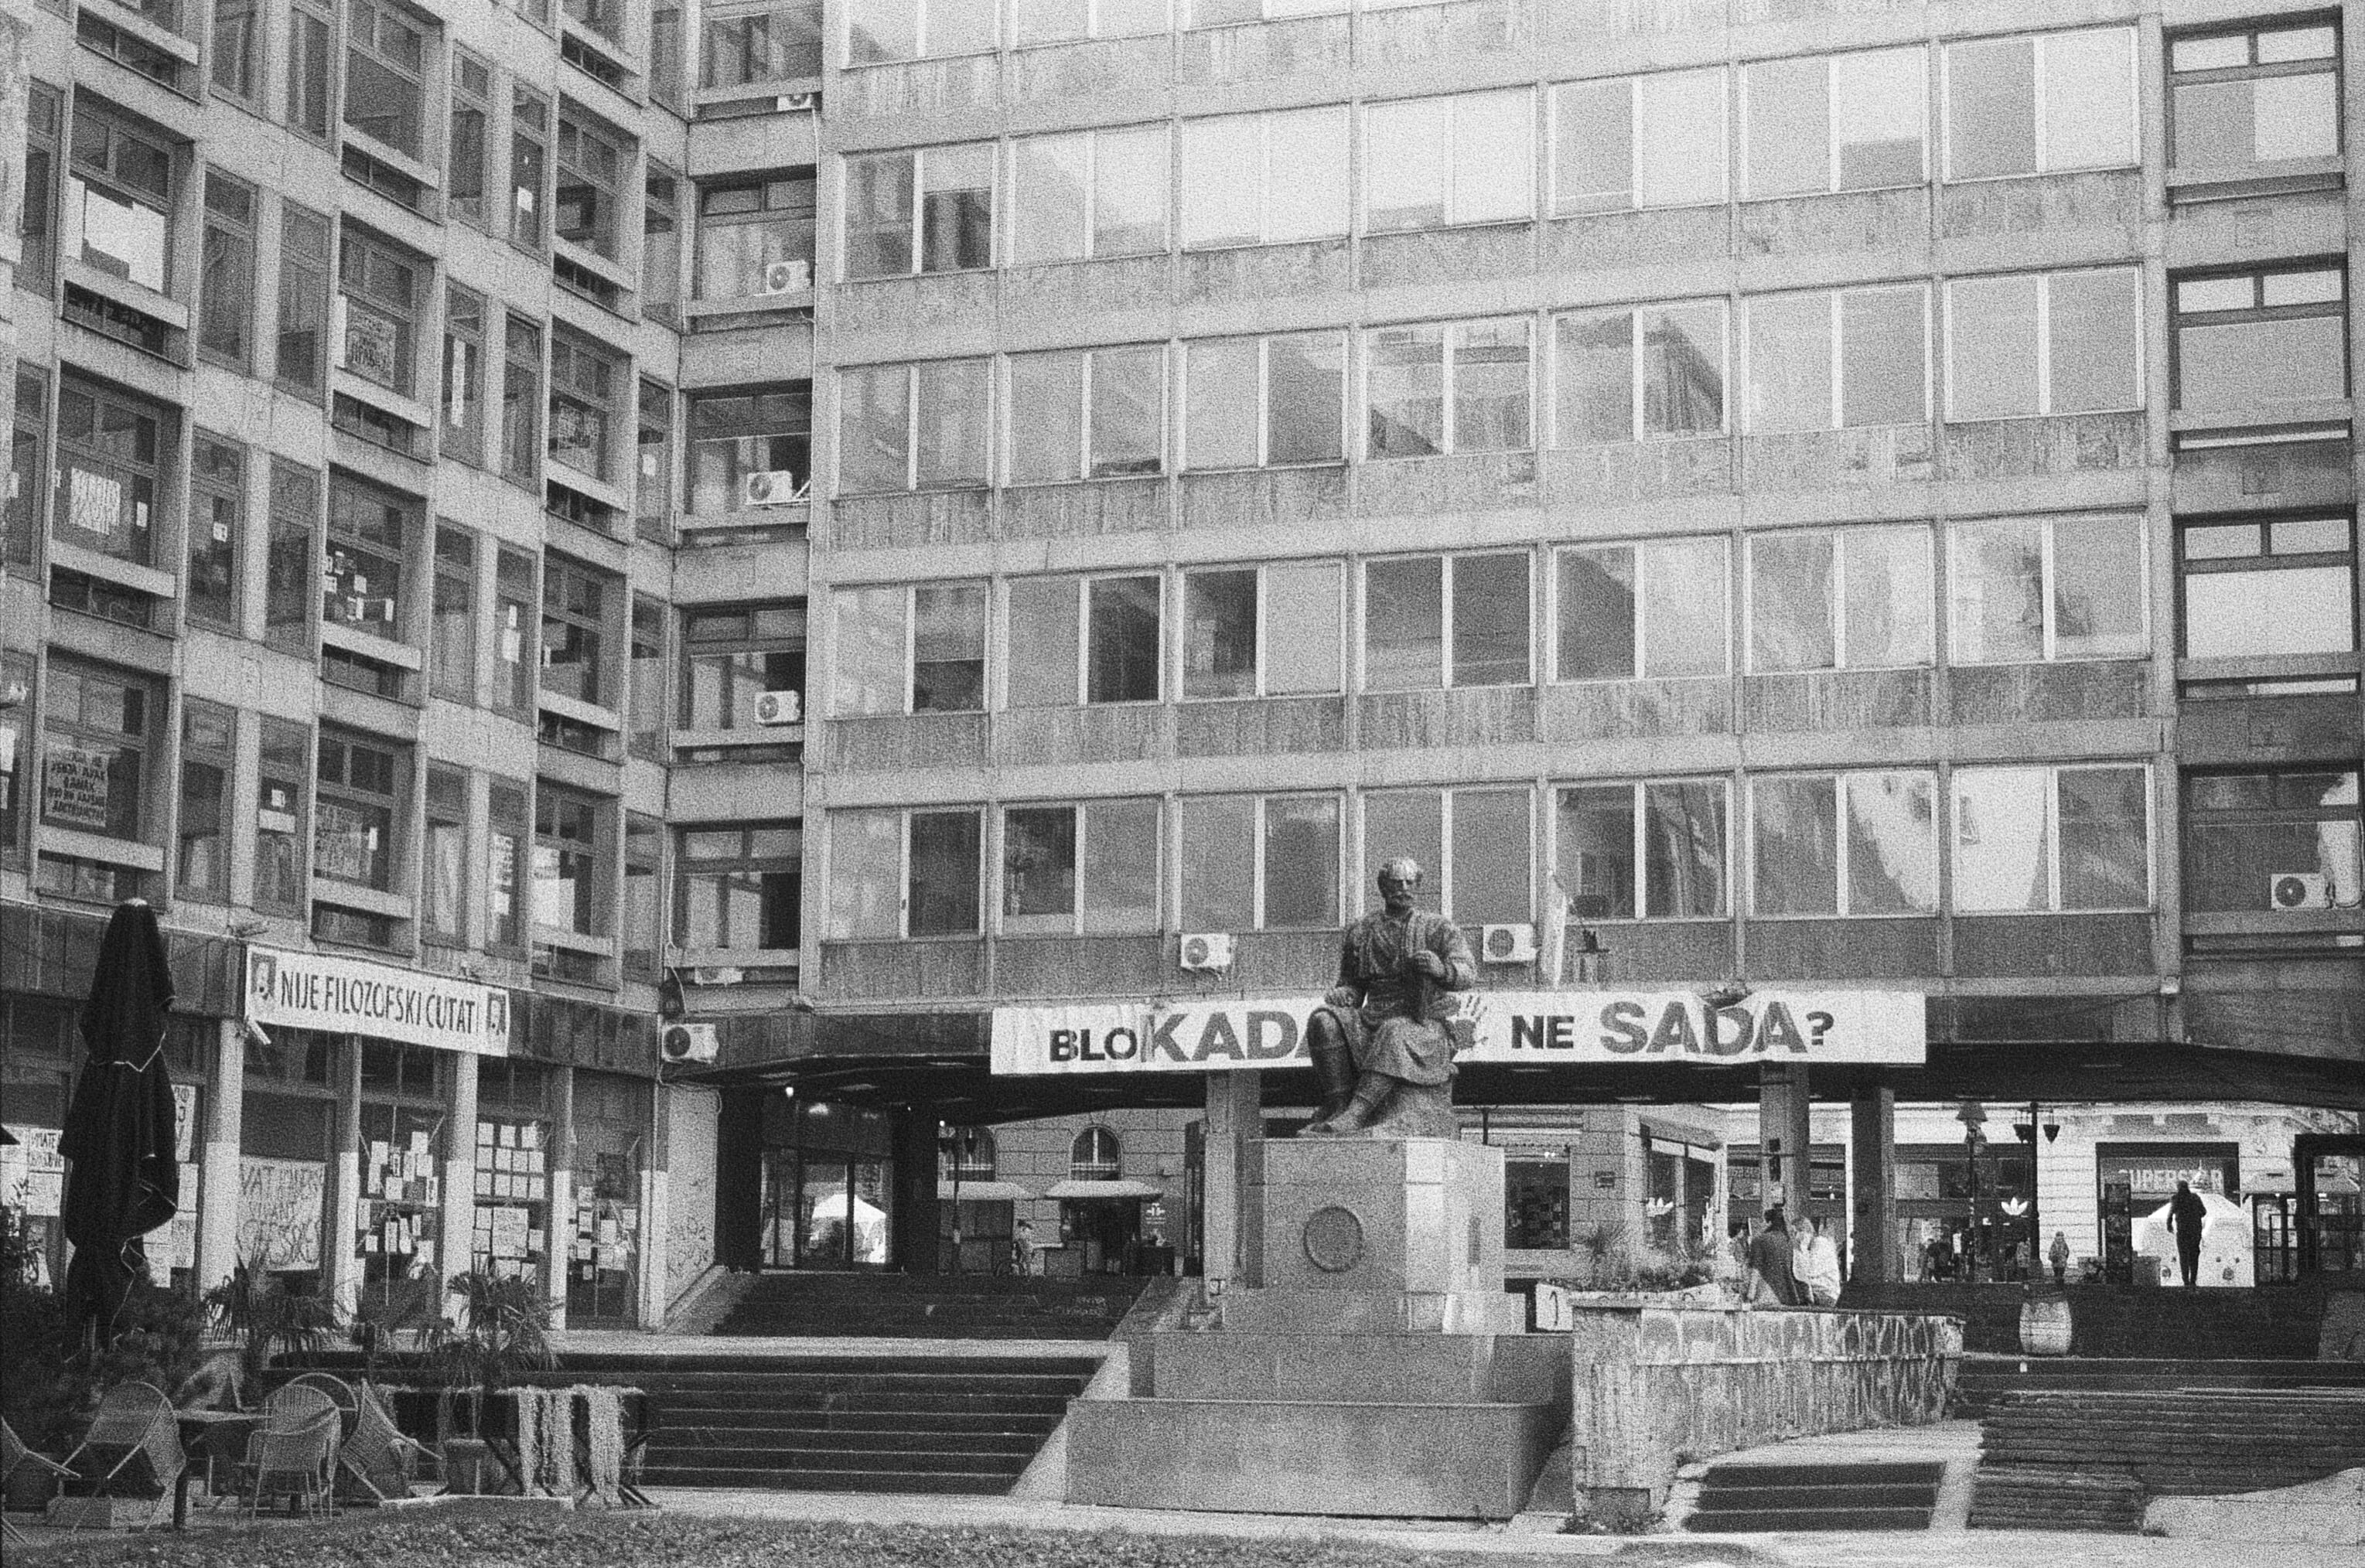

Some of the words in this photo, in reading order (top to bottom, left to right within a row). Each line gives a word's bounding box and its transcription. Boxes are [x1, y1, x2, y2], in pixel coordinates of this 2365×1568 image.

[281, 970, 319, 1011] NIJE
[323, 976, 422, 1026] FILOZOFSKI
[1510, 1014, 1575, 1050] NE
[1599, 1000, 1834, 1056] SADA?
